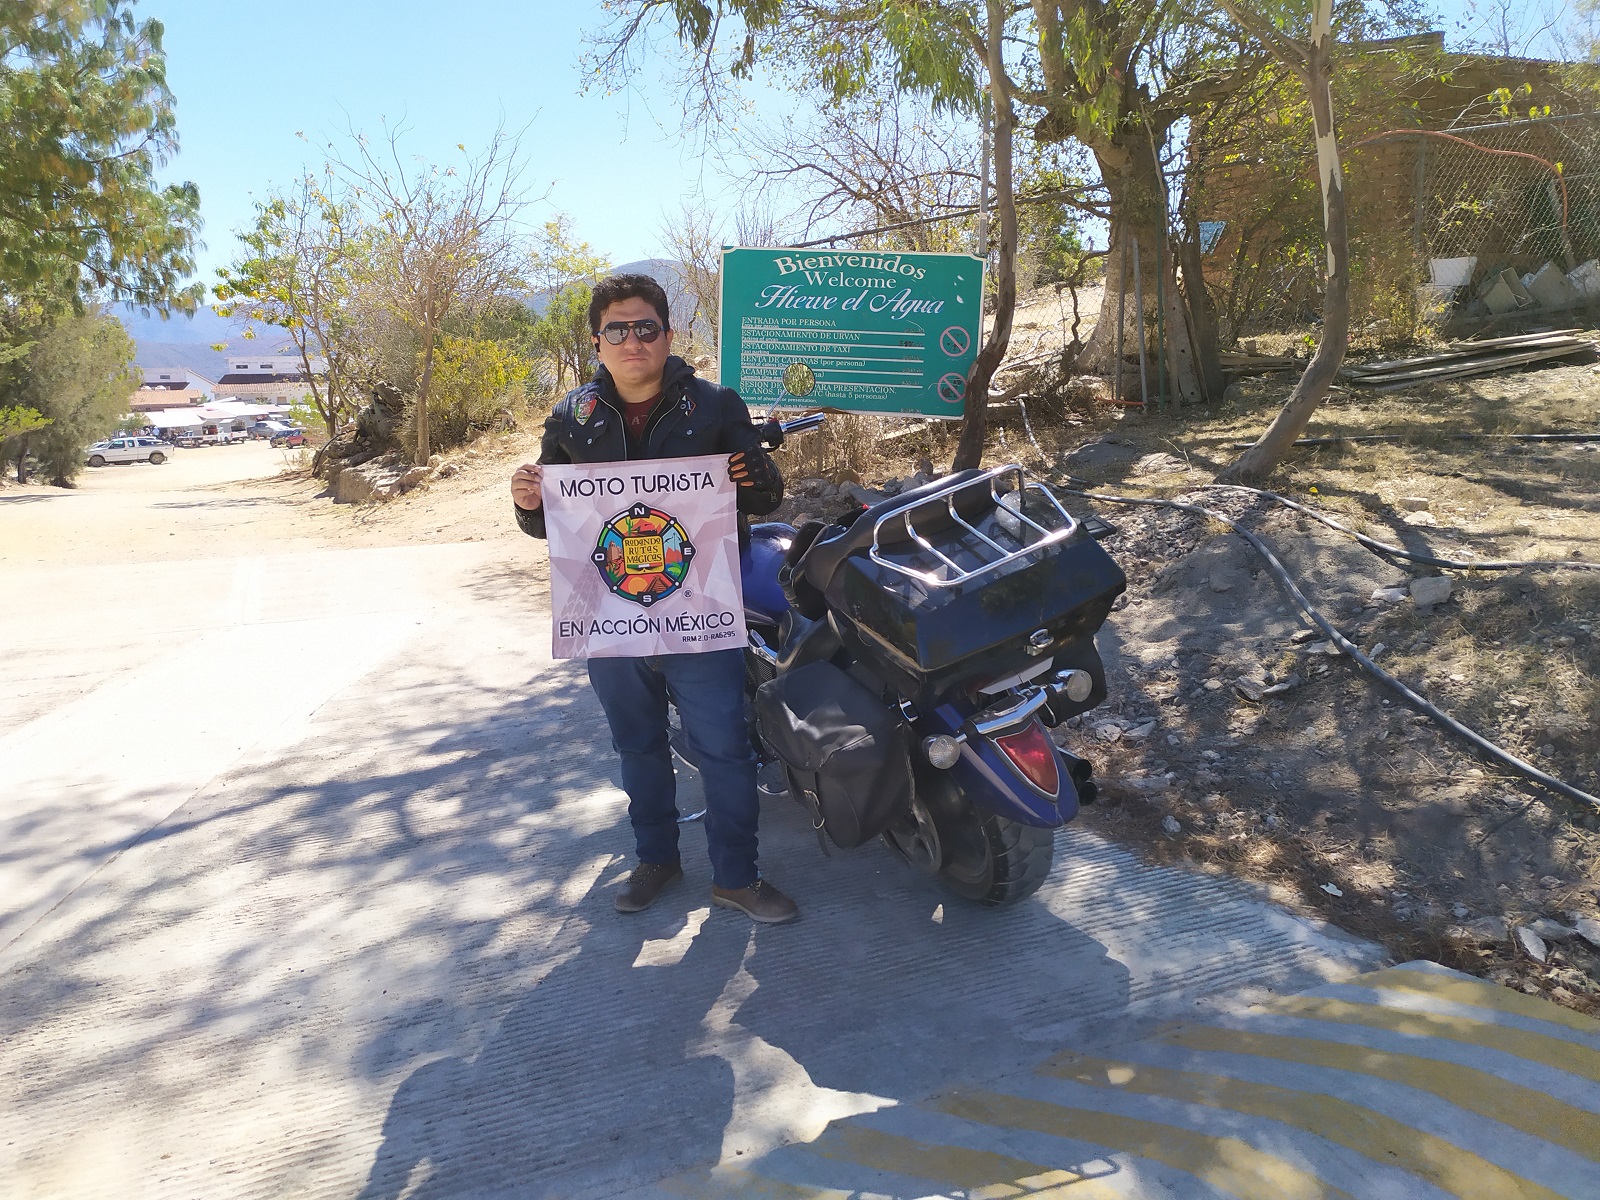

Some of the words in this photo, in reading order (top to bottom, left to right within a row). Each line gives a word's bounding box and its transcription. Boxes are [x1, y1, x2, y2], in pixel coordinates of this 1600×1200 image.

[773, 253, 927, 280] Bienvenidos
[803, 270, 897, 289] Welcome
[754, 284, 838, 310] Hierve
[842, 289, 869, 311] el
[869, 288, 945, 320] Agua
[742, 317, 779, 325] ENTRADA
[781, 318, 797, 326] POR
[799, 319, 837, 327] PERSONA
[742, 329, 818, 339] ESTACIONAMIENTO
[833, 332, 860, 340] URVAN
[741, 342, 818, 352] ESTACIONAMIENTO
[832, 345, 851, 353] TAXI
[741, 355, 766, 363] RENTA
[820, 358, 834, 367] (por
[740, 368, 778, 376] ACAMPAR
[825, 390, 847, 399] (hasta
[855, 392, 888, 400] personas)
[559, 477, 625, 497] MOTO
[631, 472, 715, 494] TURISTA
[634, 507, 645, 515] N
[683, 547, 693, 555] E
[594, 553, 605, 561] O
[642, 594, 652, 603] S
[559, 620, 584, 637] EN
[589, 614, 661, 636] ACCIÓN
[666, 611, 735, 633] MÉXICO
[682, 635, 698, 643] RRM
